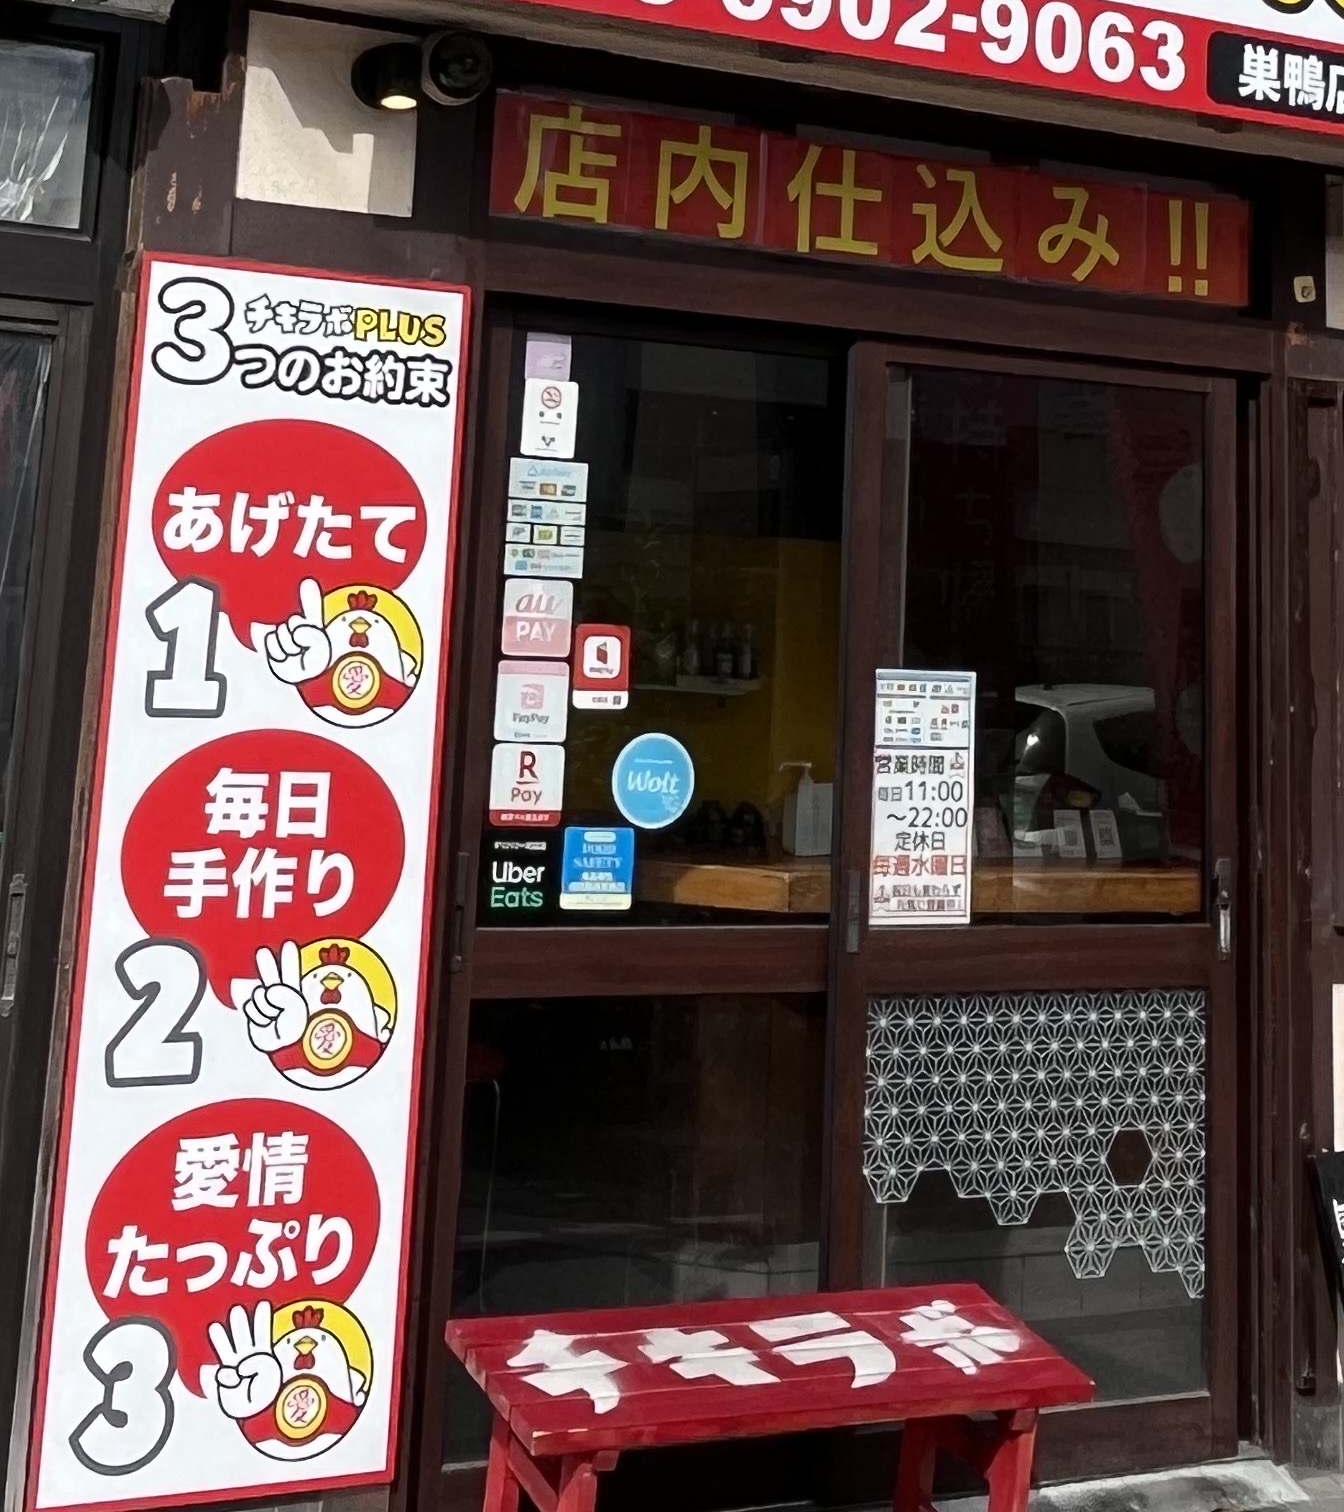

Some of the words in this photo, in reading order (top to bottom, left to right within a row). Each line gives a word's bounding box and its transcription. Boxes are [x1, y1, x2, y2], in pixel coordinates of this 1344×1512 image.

[243, 293, 448, 347] チキラボPLUS
[162, 486, 417, 564] あげたて
[144, 577, 228, 718] 1
[516, 621, 556, 643] PAY
[204, 767, 331, 839] 毎日
[510, 787, 543, 806] Pay
[627, 771, 680, 796] Wolt
[492, 861, 546, 884] Uber
[894, 831, 946, 853] 定休日
[163, 847, 355, 919] 手作り
[490, 886, 544, 908] Eats
[104, 935, 207, 1088] 2
[171, 1130, 310, 1211] 愛情
[102, 1213, 354, 1299] たっぷり
[68, 1315, 178, 1477] 3
